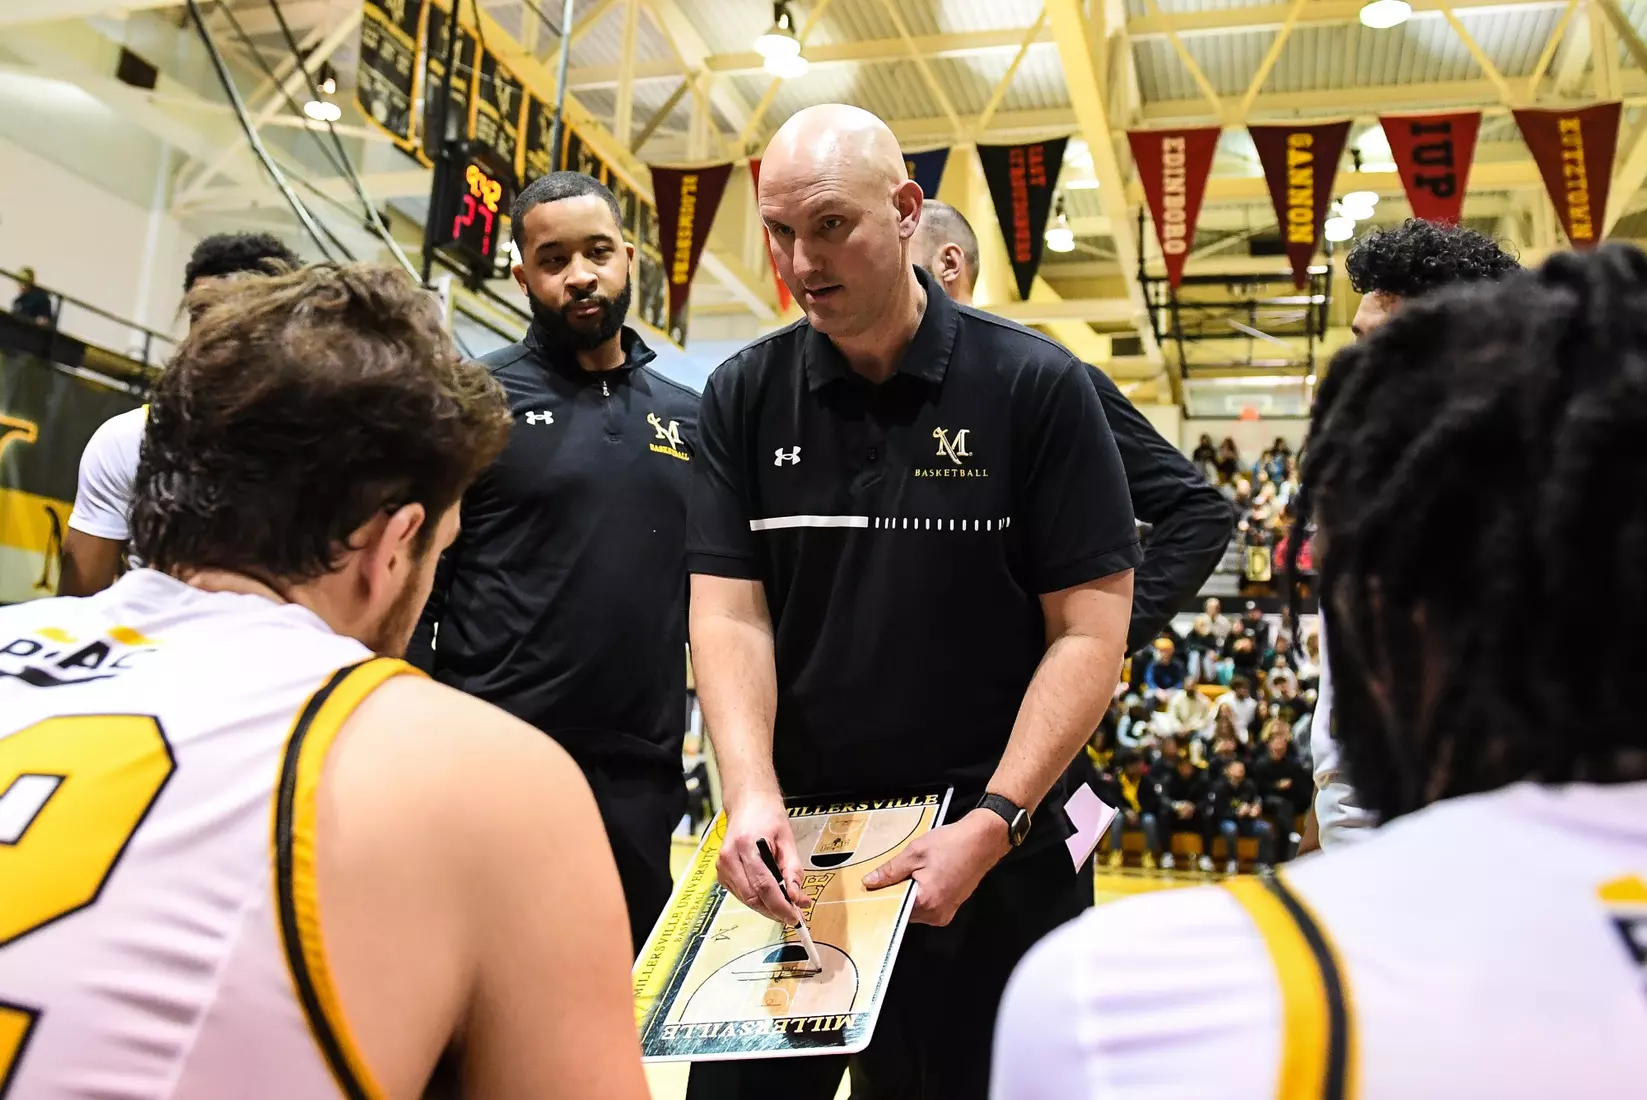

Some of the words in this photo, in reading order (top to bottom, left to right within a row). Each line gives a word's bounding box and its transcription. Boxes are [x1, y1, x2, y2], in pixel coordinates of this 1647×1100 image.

[1162, 136, 1186, 254] EDINBORO
[1287, 132, 1314, 243] GANNON
[1410, 121, 1456, 198] IUP
[1558, 116, 1594, 239] KUTZTOWN
[649, 443, 690, 461] BASKETBALL
[914, 468, 989, 478] BASKETBALL
[633, 909, 680, 998] MILLERSVILLE
[677, 846, 718, 914] UNIVERSITY
[673, 890, 708, 943] BASKETBALL
[661, 1014, 858, 1040] MILLERSVILLE
